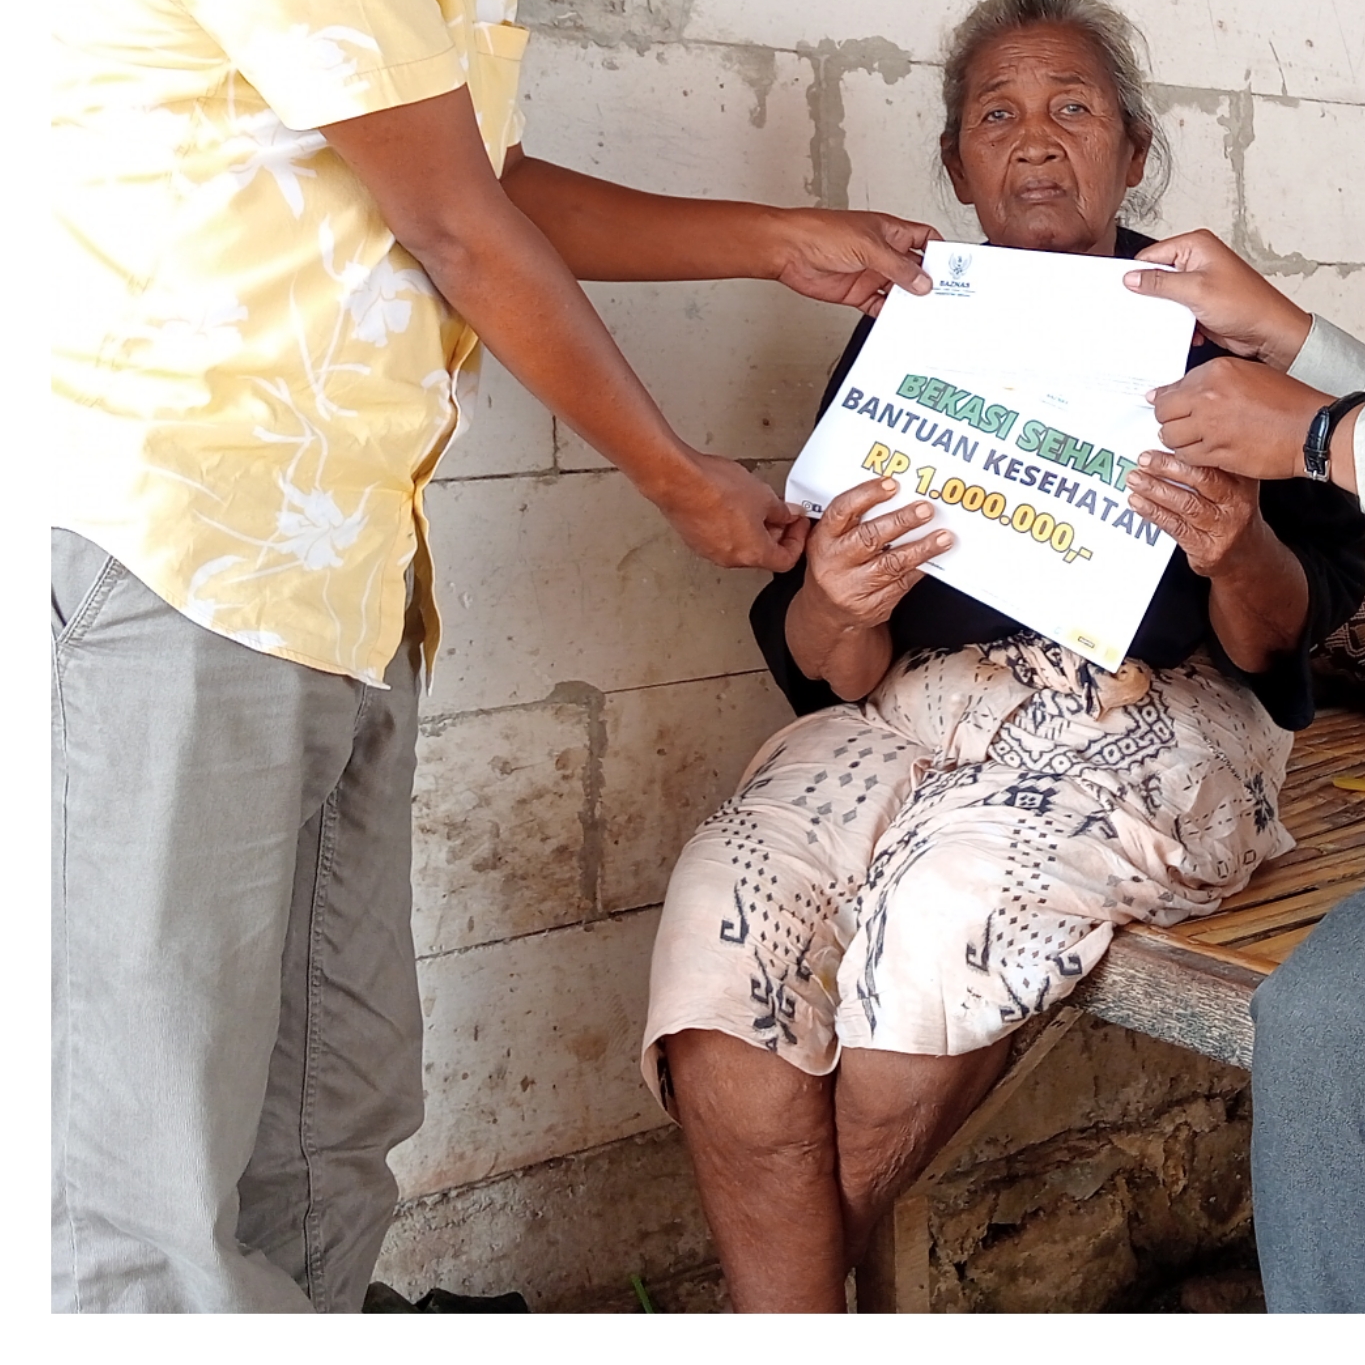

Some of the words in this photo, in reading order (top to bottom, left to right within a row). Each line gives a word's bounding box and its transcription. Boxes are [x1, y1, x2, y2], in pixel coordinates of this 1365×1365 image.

[841, 387, 981, 463] BANTUAN
[983, 449, 1161, 547] KESEHATAN
[897, 374, 1019, 440] BEKASI
[1017, 420, 1139, 493] SEHAT
[861, 441, 911, 478] RP
[915, 465, 1093, 564] 1.000.000,-
